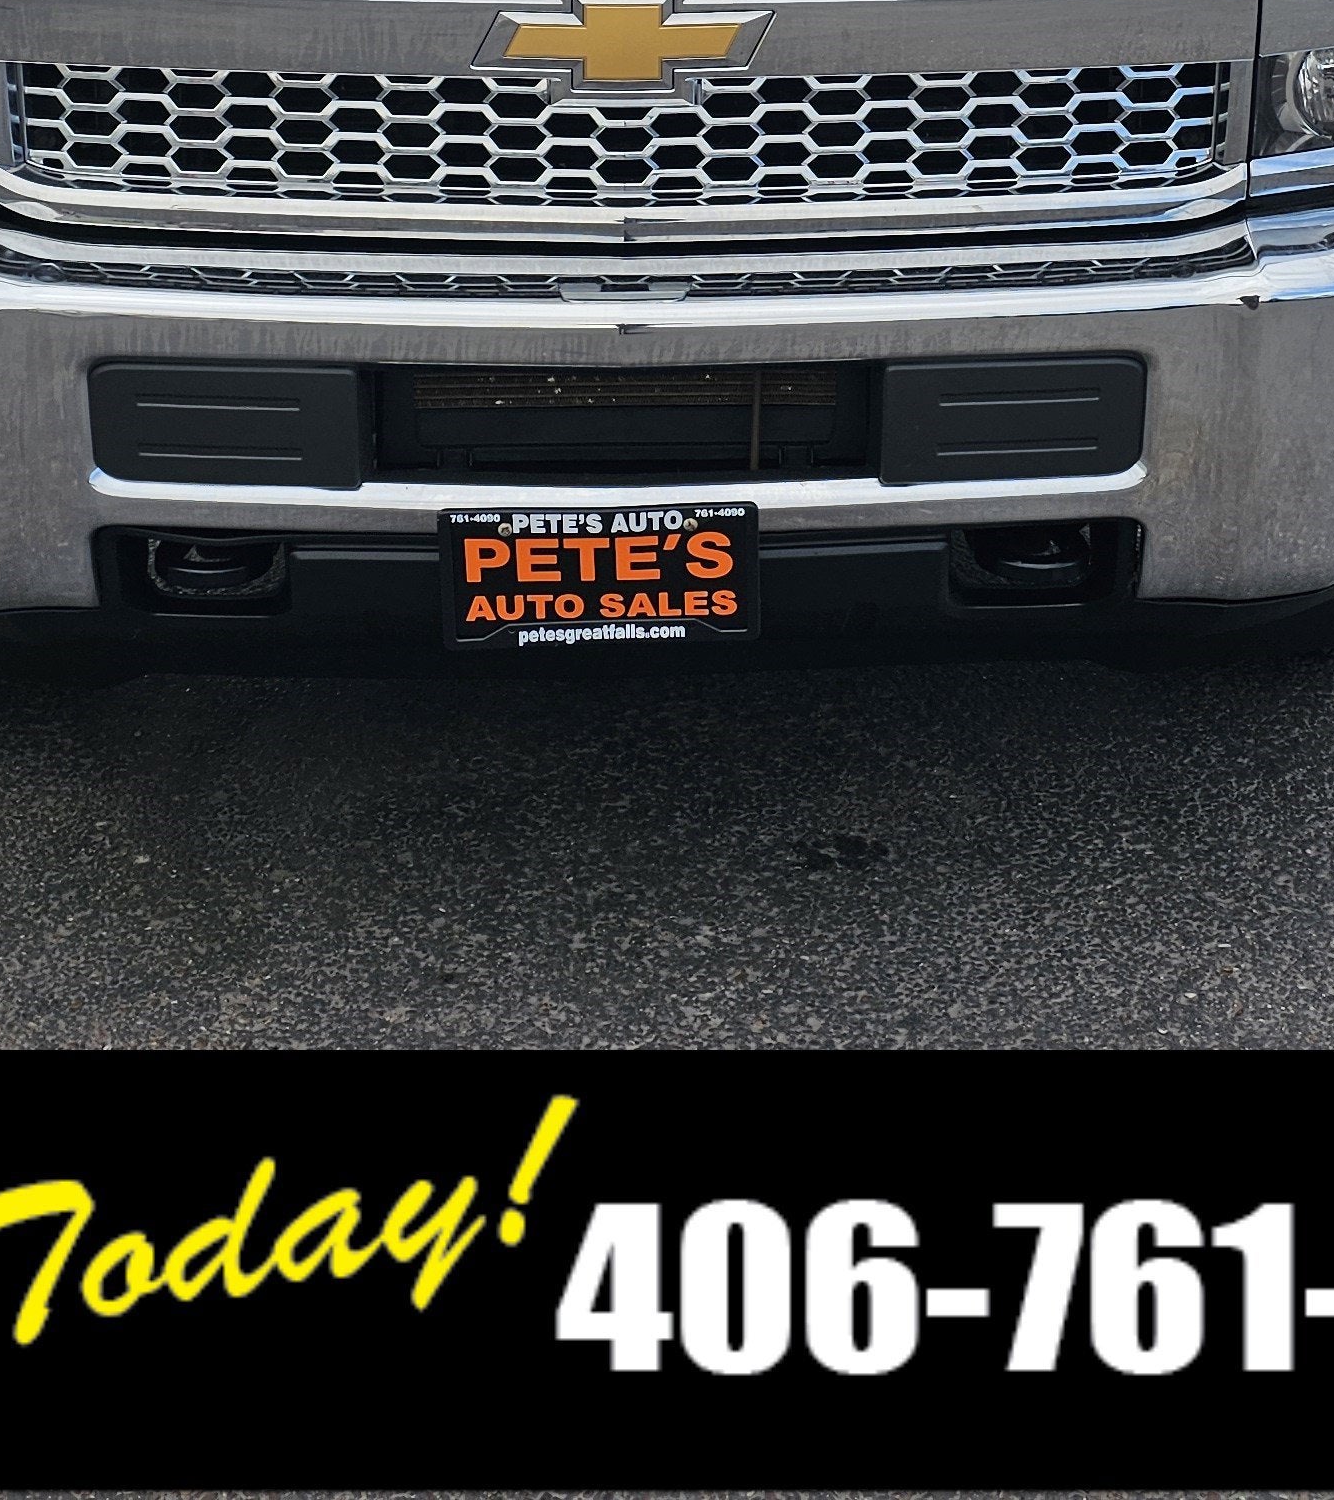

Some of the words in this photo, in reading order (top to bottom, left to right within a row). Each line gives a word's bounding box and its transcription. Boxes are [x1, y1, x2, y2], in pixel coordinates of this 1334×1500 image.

[512, 513, 604, 534] PETE'S
[610, 510, 684, 533] AUTO
[464, 531, 734, 583] PETE'S
[466, 593, 585, 621] AUTO
[599, 589, 738, 617] SALES
[518, 623, 686, 646] petesgreatfalls.com
